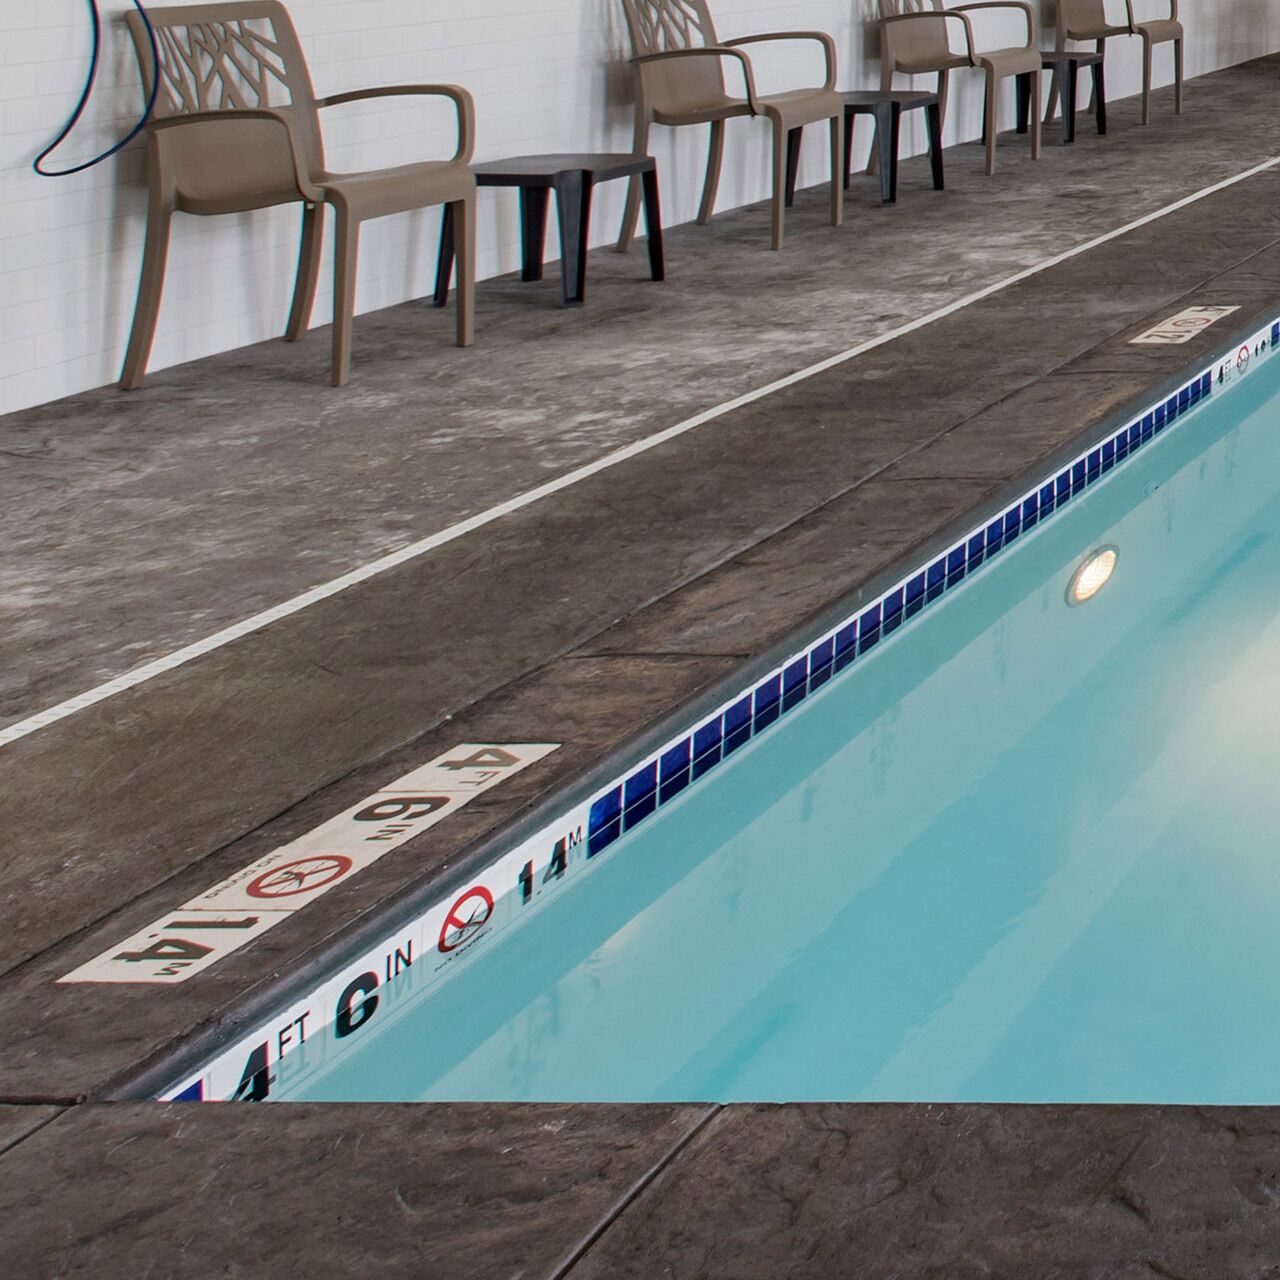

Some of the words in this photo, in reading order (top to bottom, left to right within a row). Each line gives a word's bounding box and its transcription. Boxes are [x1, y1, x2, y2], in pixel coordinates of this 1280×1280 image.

[436, 748, 521, 771] 4
[352, 796, 450, 821] 6
[278, 1010, 311, 1060] FT
[335, 971, 380, 1040] 6
[386, 938, 413, 982] IN
